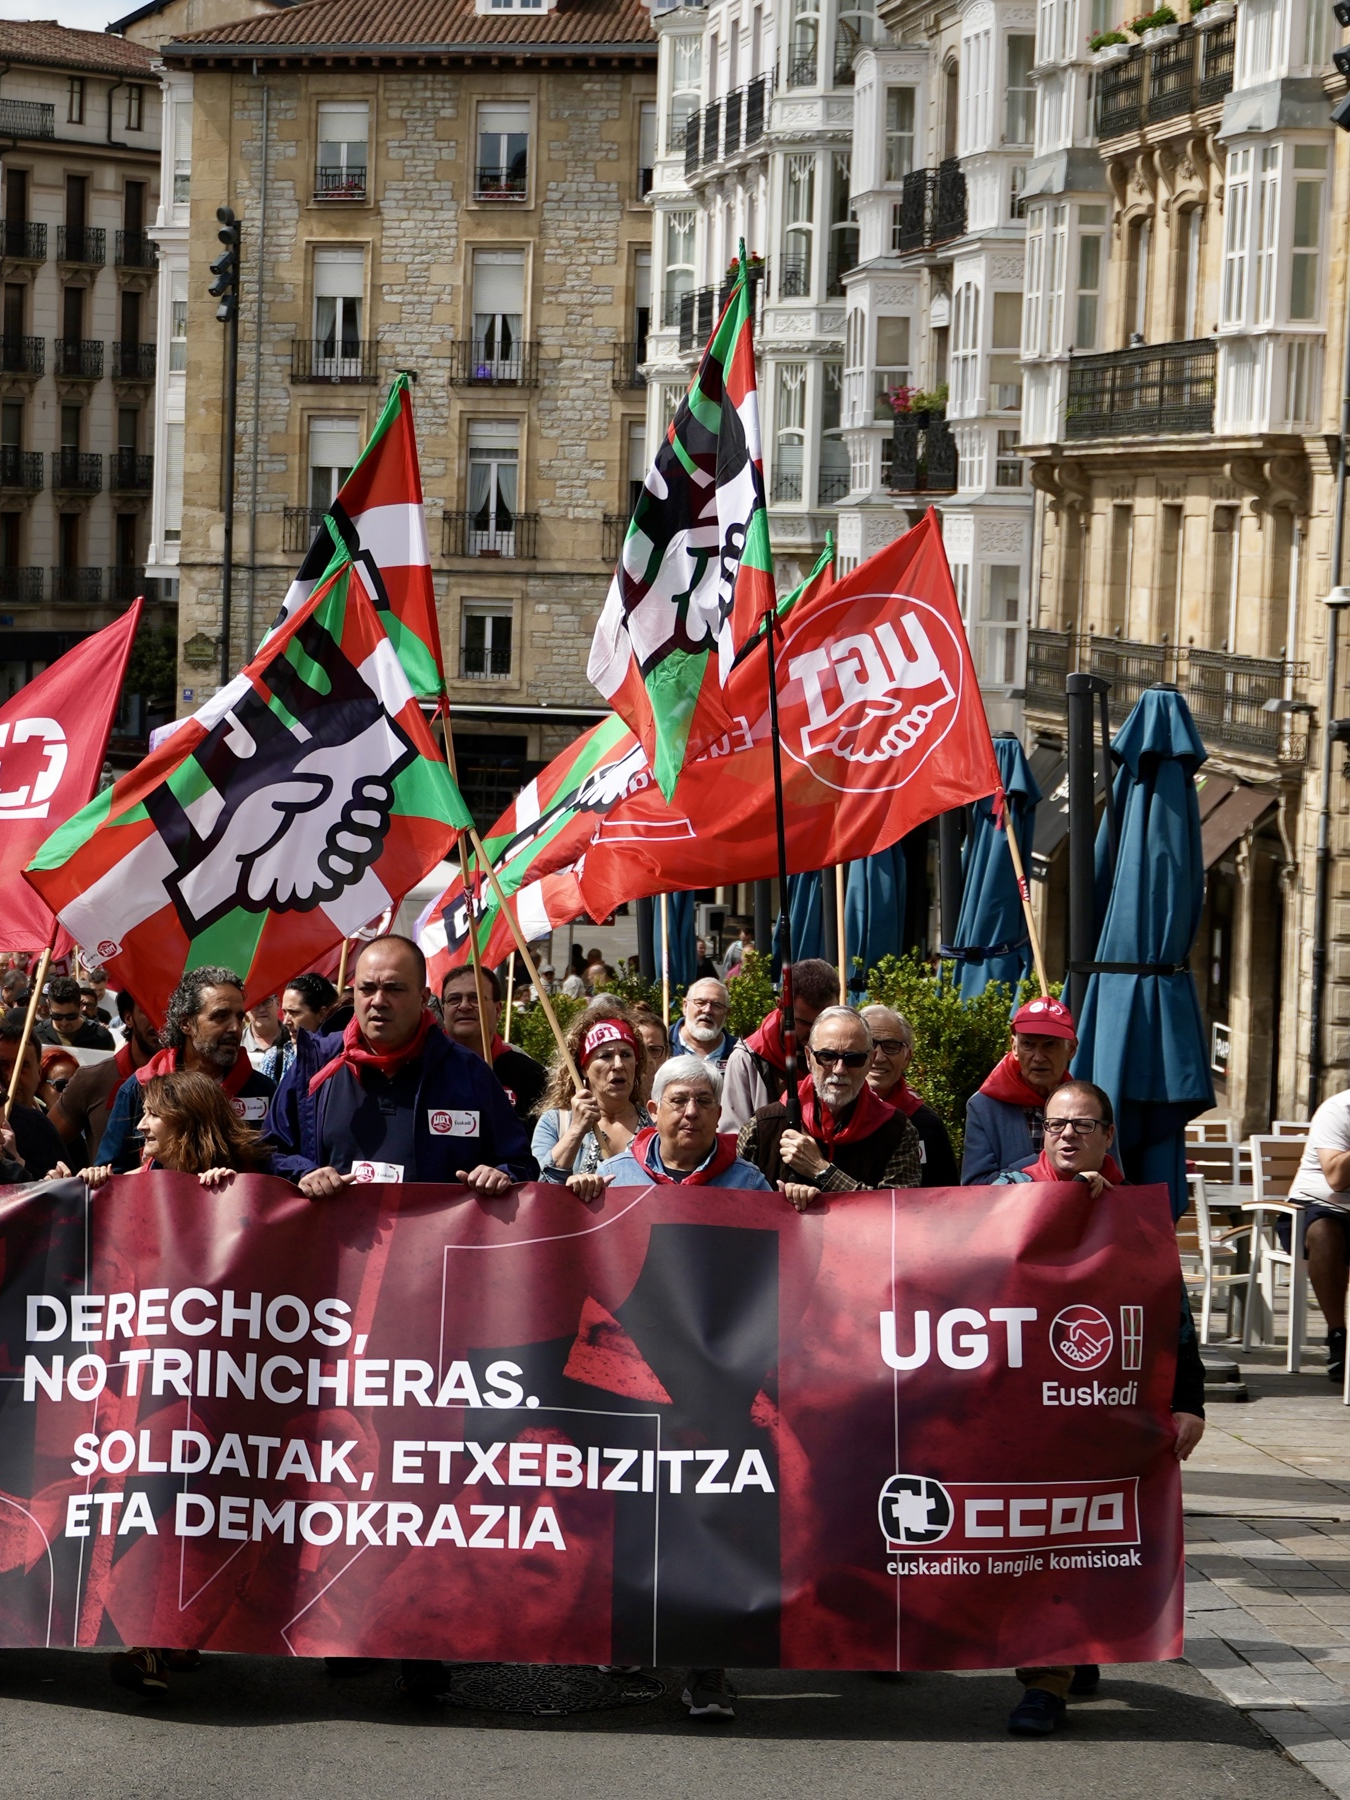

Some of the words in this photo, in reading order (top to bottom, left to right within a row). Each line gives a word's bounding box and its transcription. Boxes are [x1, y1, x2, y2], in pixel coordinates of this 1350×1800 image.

[586, 1026, 615, 1046] UGT
[433, 1114, 451, 1125] UGT
[25, 1287, 367, 1357] DERECHOS,
[879, 1306, 1038, 1372] UGT
[22, 1353, 106, 1403] NO
[117, 1348, 540, 1409] TRINCHERAS.
[1042, 1380, 1137, 1406] Euskadi
[69, 1428, 374, 1490] SOLDATAK,
[390, 1440, 778, 1495] ETXEBIZITZA
[64, 1490, 157, 1539] ETA
[173, 1494, 566, 1552] DEMOKRAZIA
[964, 1492, 1124, 1538] CCOO
[886, 1554, 981, 1577] euskadiko
[986, 1555, 1044, 1579] langile
[1048, 1548, 1143, 1571] komisioak
